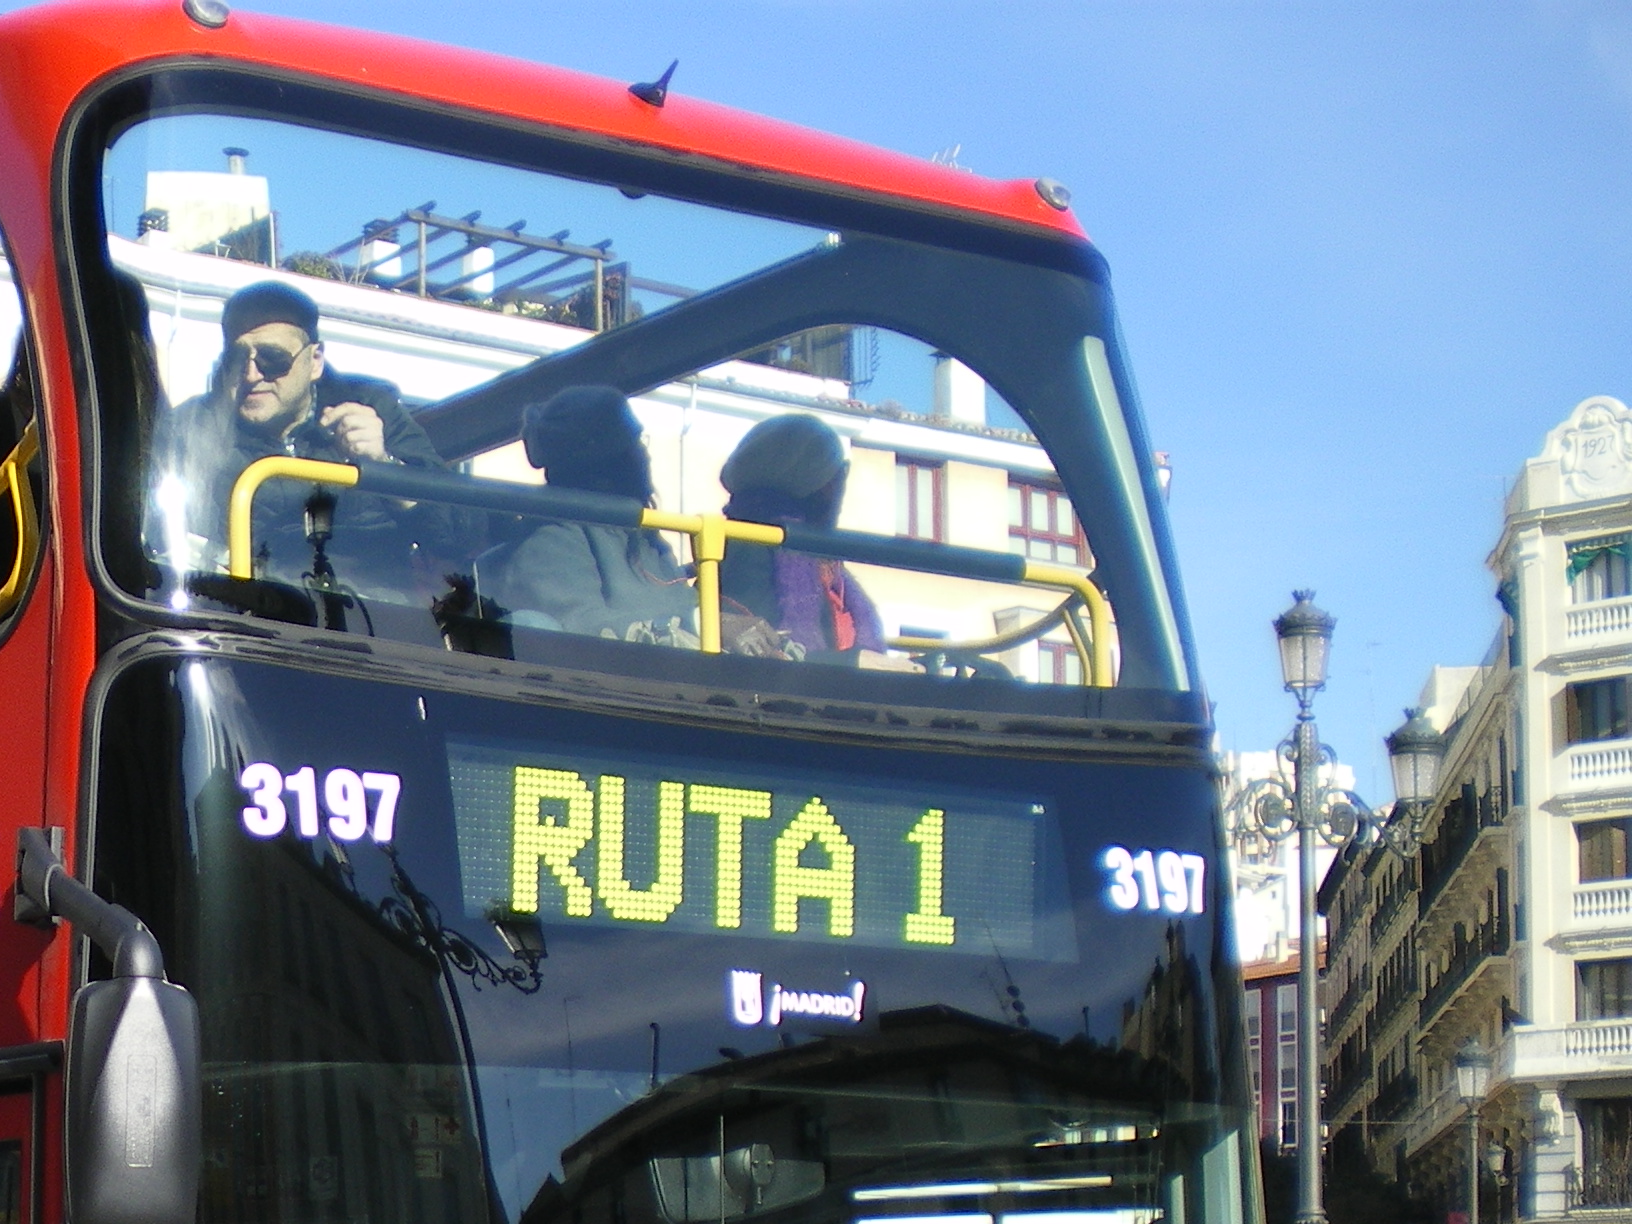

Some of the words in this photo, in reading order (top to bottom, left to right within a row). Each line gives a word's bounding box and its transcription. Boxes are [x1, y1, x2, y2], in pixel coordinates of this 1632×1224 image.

[1581, 434, 1615, 459] 1927
[240, 762, 401, 842] 3197
[511, 765, 856, 937] RUTA
[905, 808, 956, 945] 1
[1104, 845, 1206, 914] 3197
